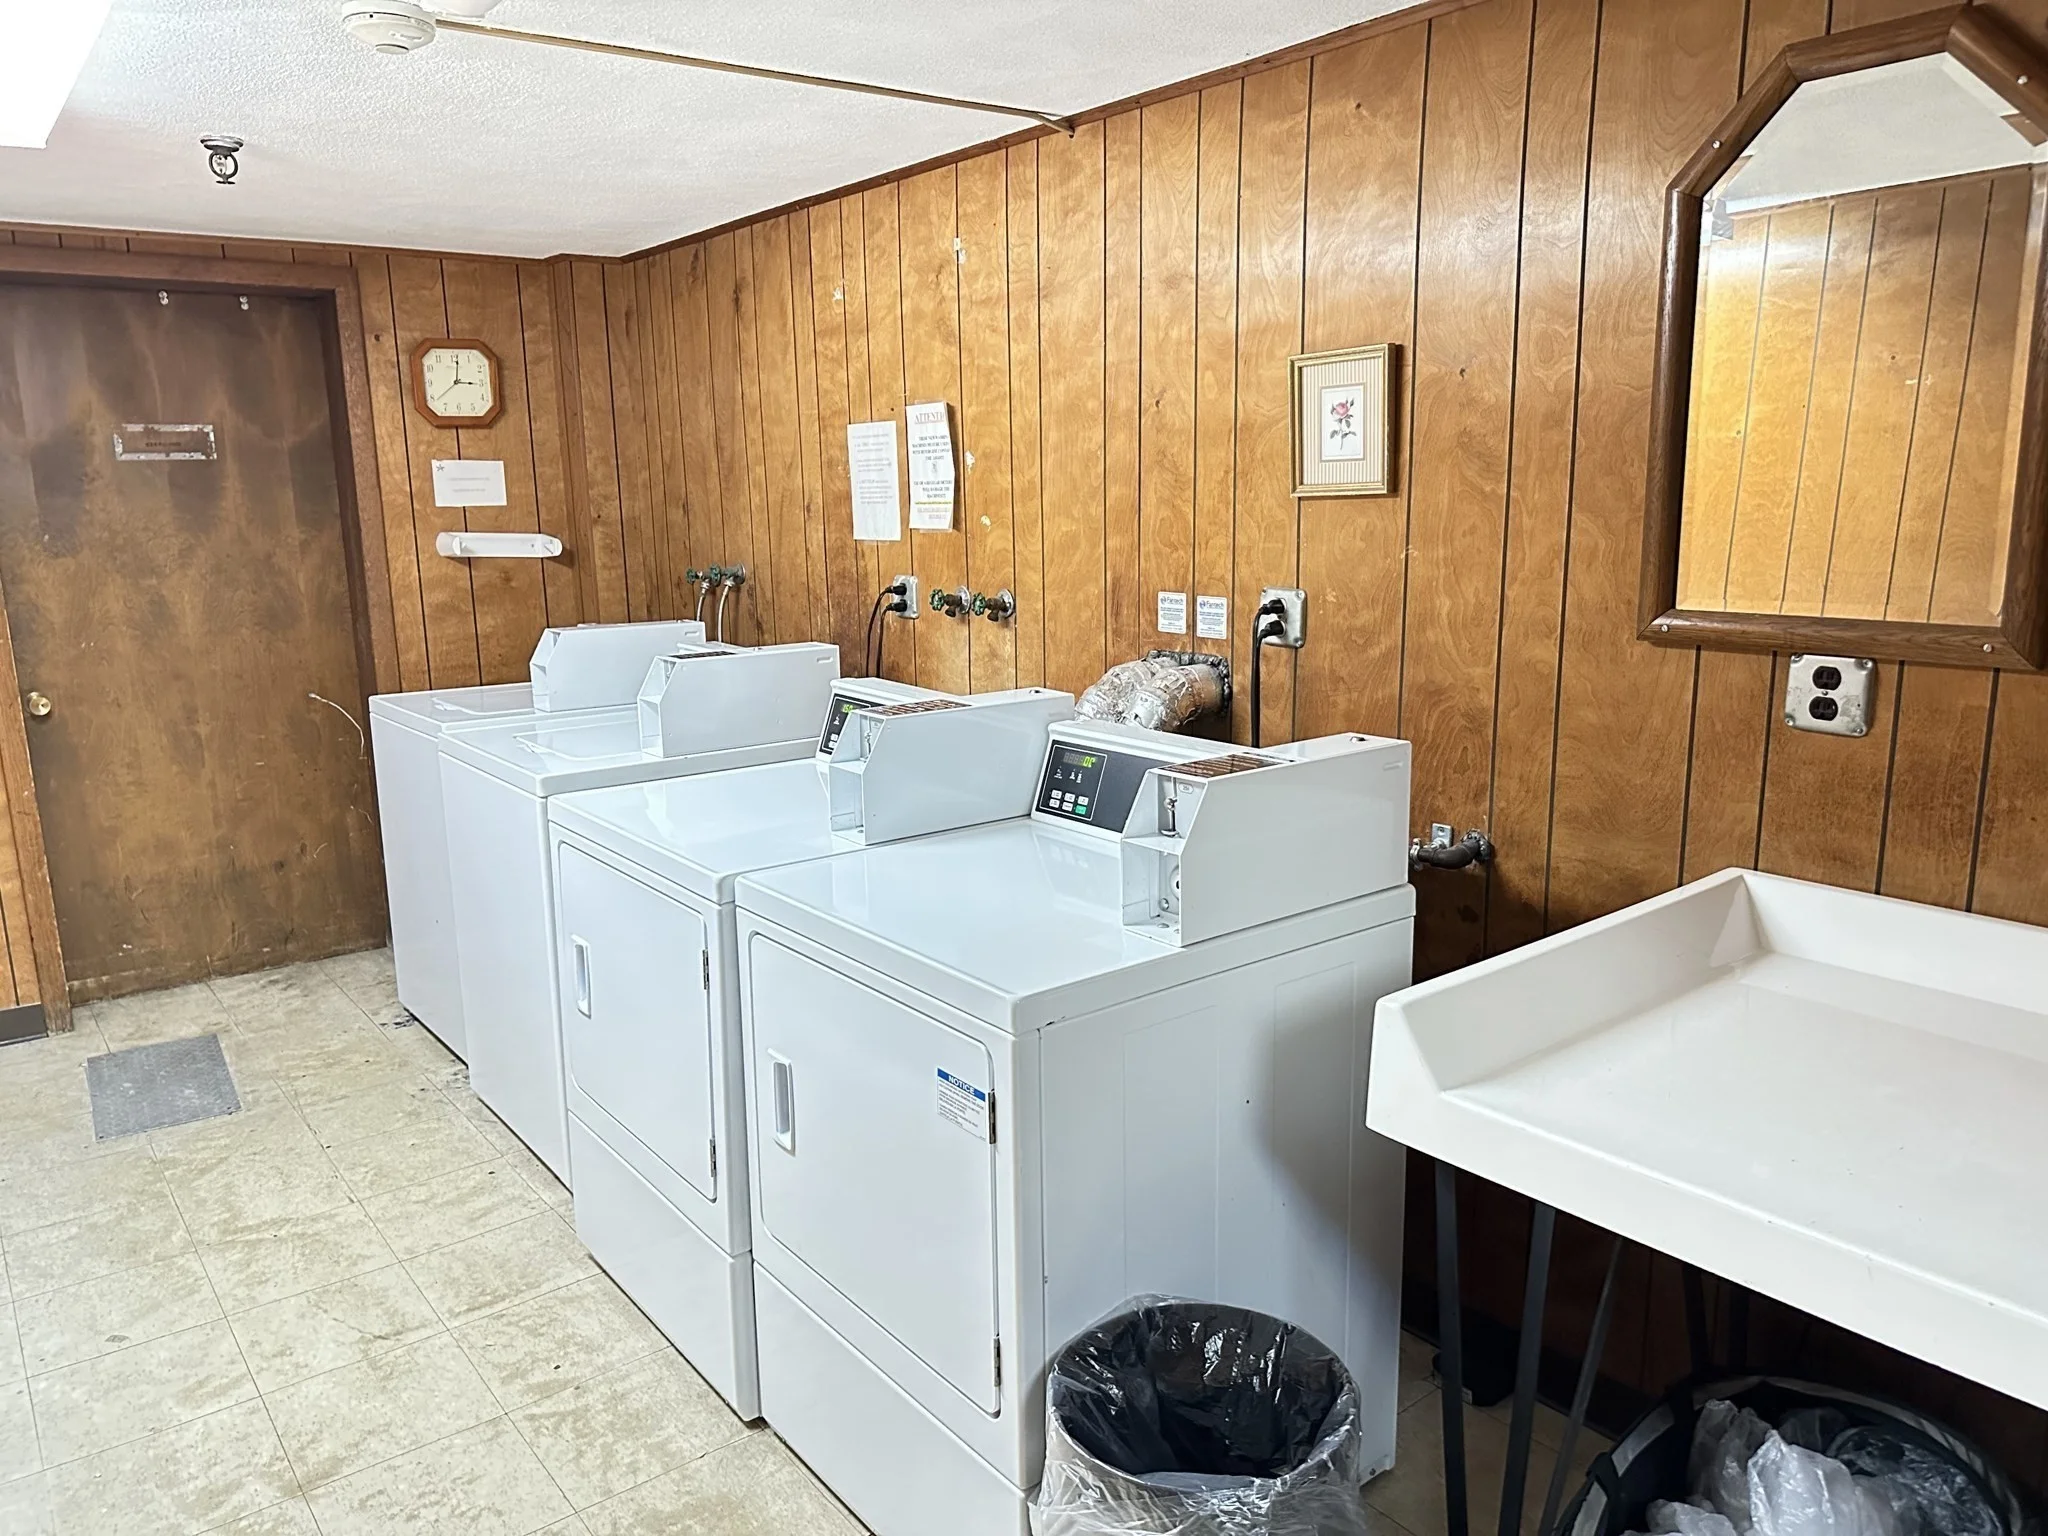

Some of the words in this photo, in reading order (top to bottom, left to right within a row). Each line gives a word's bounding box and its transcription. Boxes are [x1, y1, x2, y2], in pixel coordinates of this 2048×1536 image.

[436, 355, 441, 363] 11
[427, 364, 433, 372] 10
[948, 1074, 975, 1095] NOTICE
